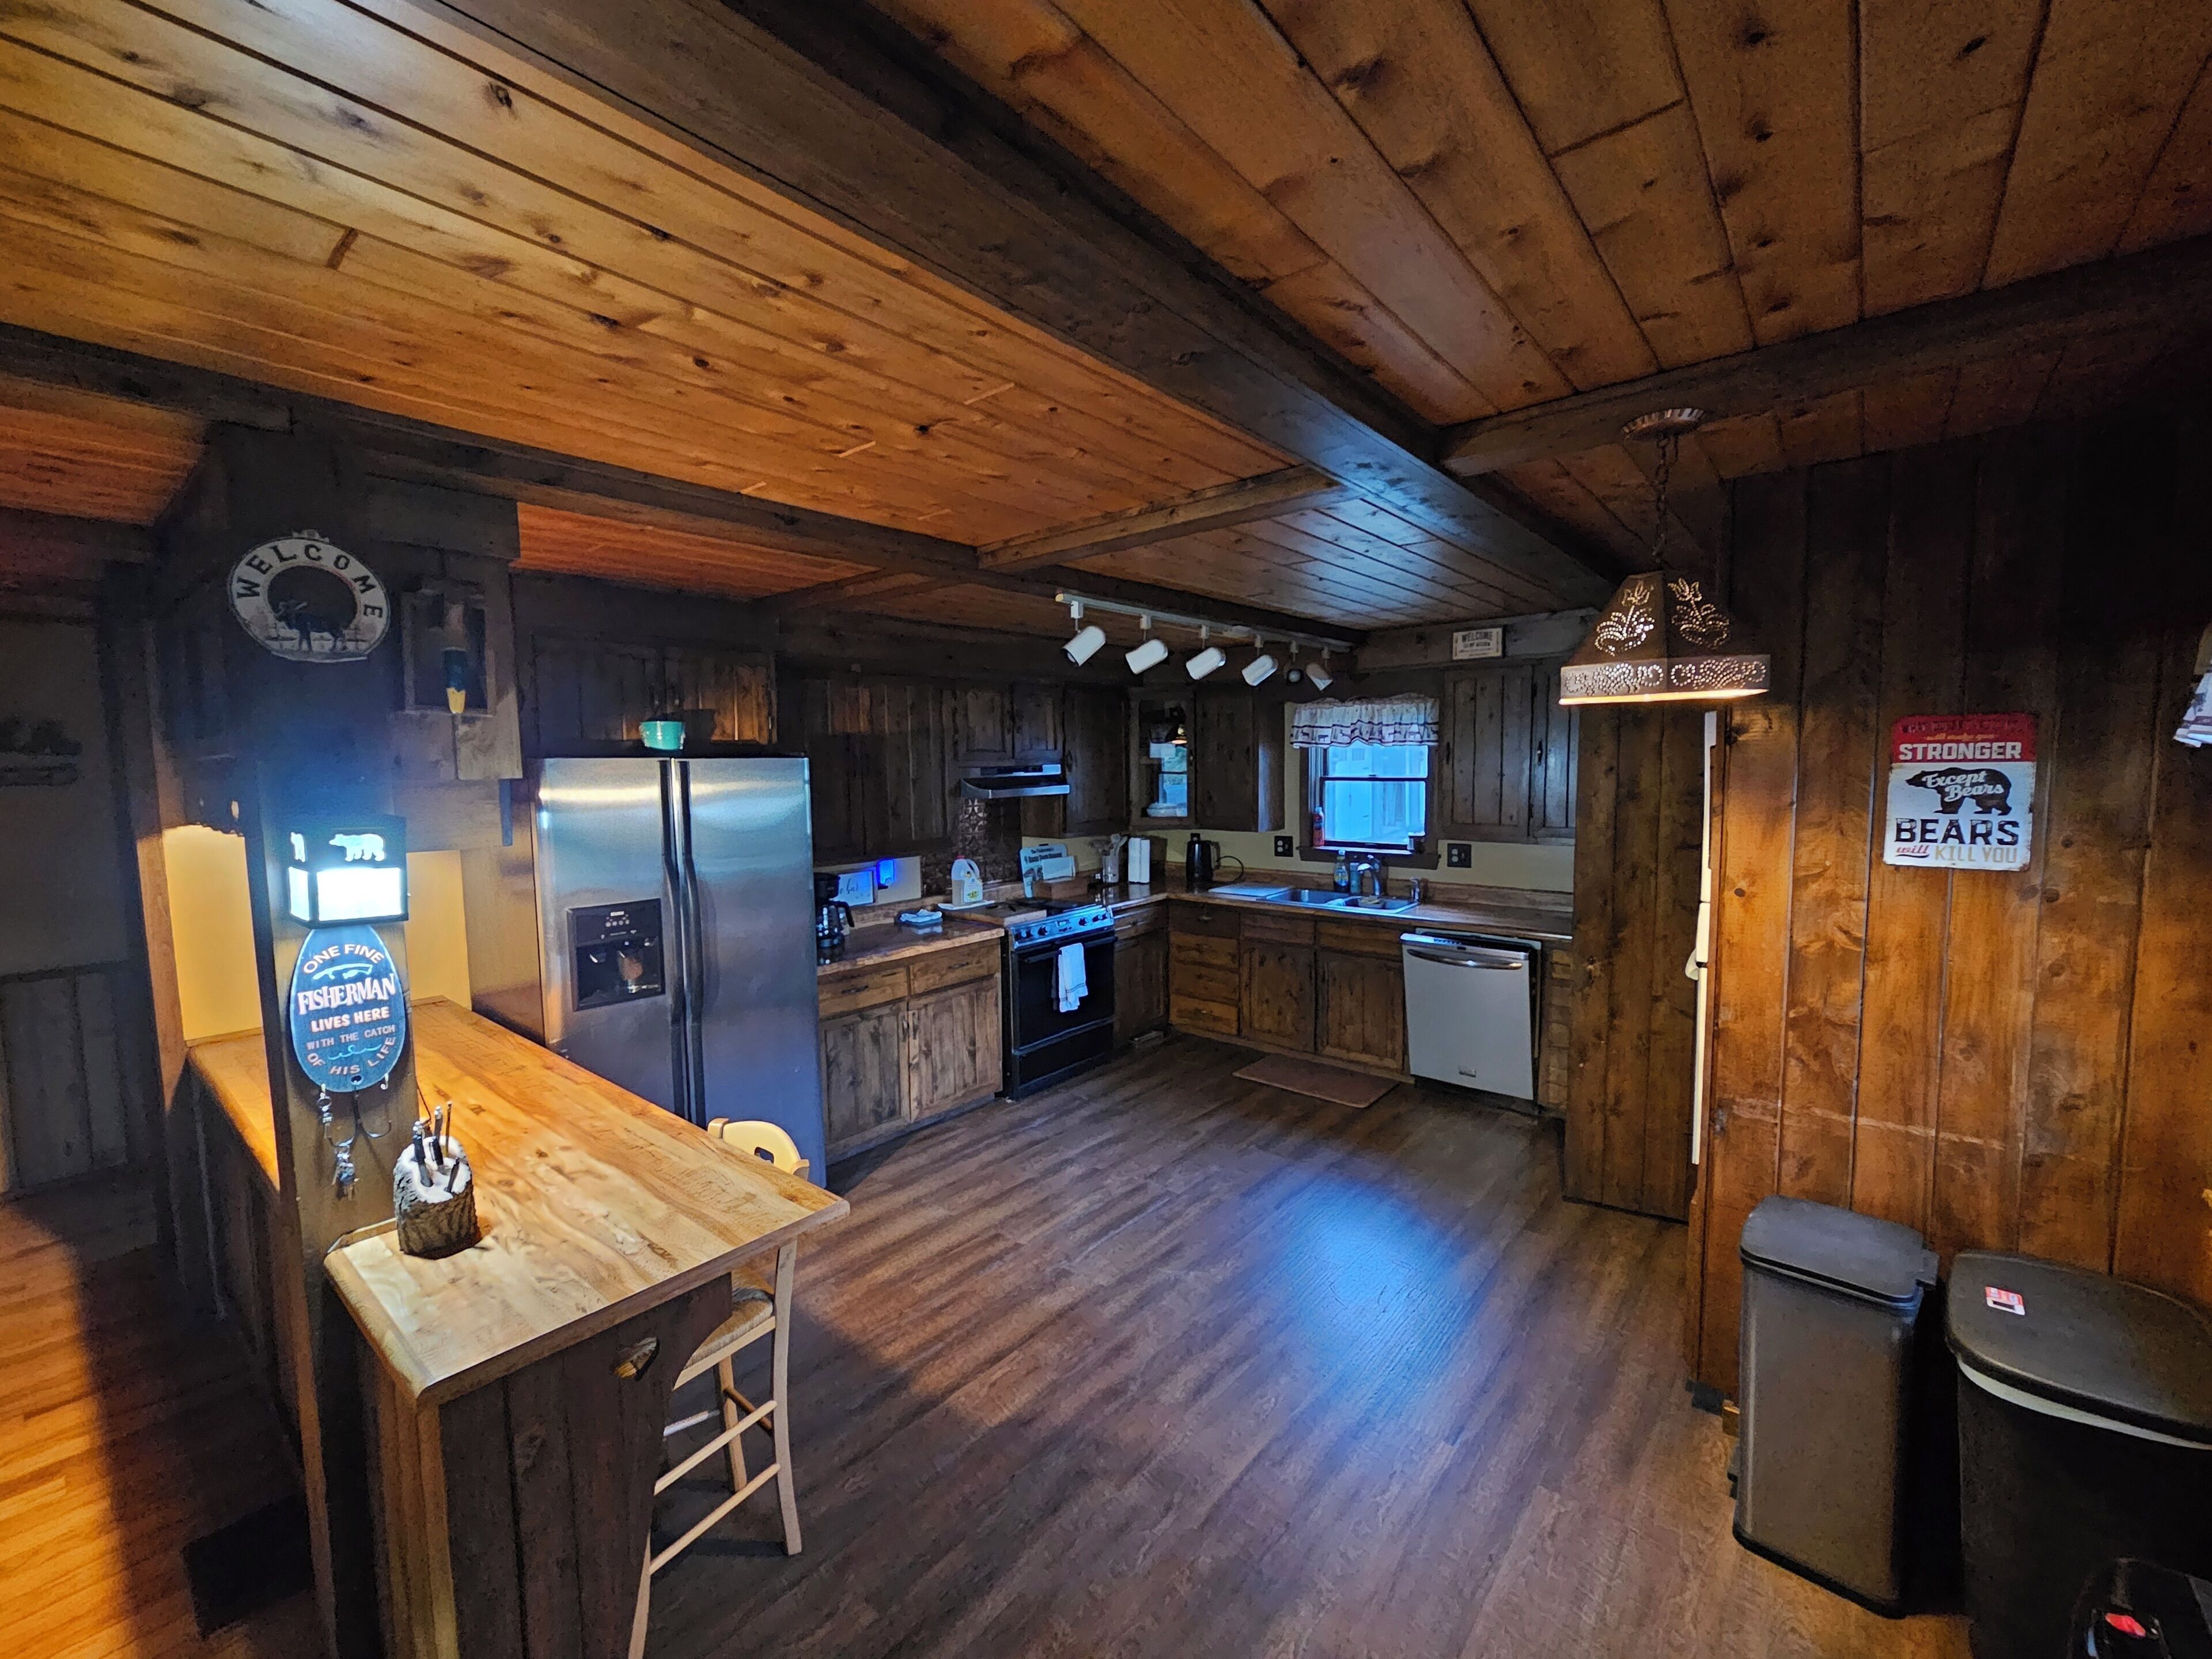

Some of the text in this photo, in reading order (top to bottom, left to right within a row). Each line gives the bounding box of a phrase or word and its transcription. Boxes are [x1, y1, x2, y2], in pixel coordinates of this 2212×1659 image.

[236, 544, 383, 619] WELCOME
[1899, 742, 2022, 760] STRONGER
[1922, 771, 1987, 787] Except
[1944, 785, 2004, 802] Bears
[1895, 818, 2020, 846] BEARS
[1896, 845, 2017, 863] will KILL YOU
[303, 944, 385, 974] ONE FINE
[297, 974, 396, 1015] FISHERMAN
[310, 1006, 390, 1033] LIVES HERE
[306, 1024, 396, 1051] WITH THE CATCH
[307, 1036, 396, 1075] OF HIS LIFE
